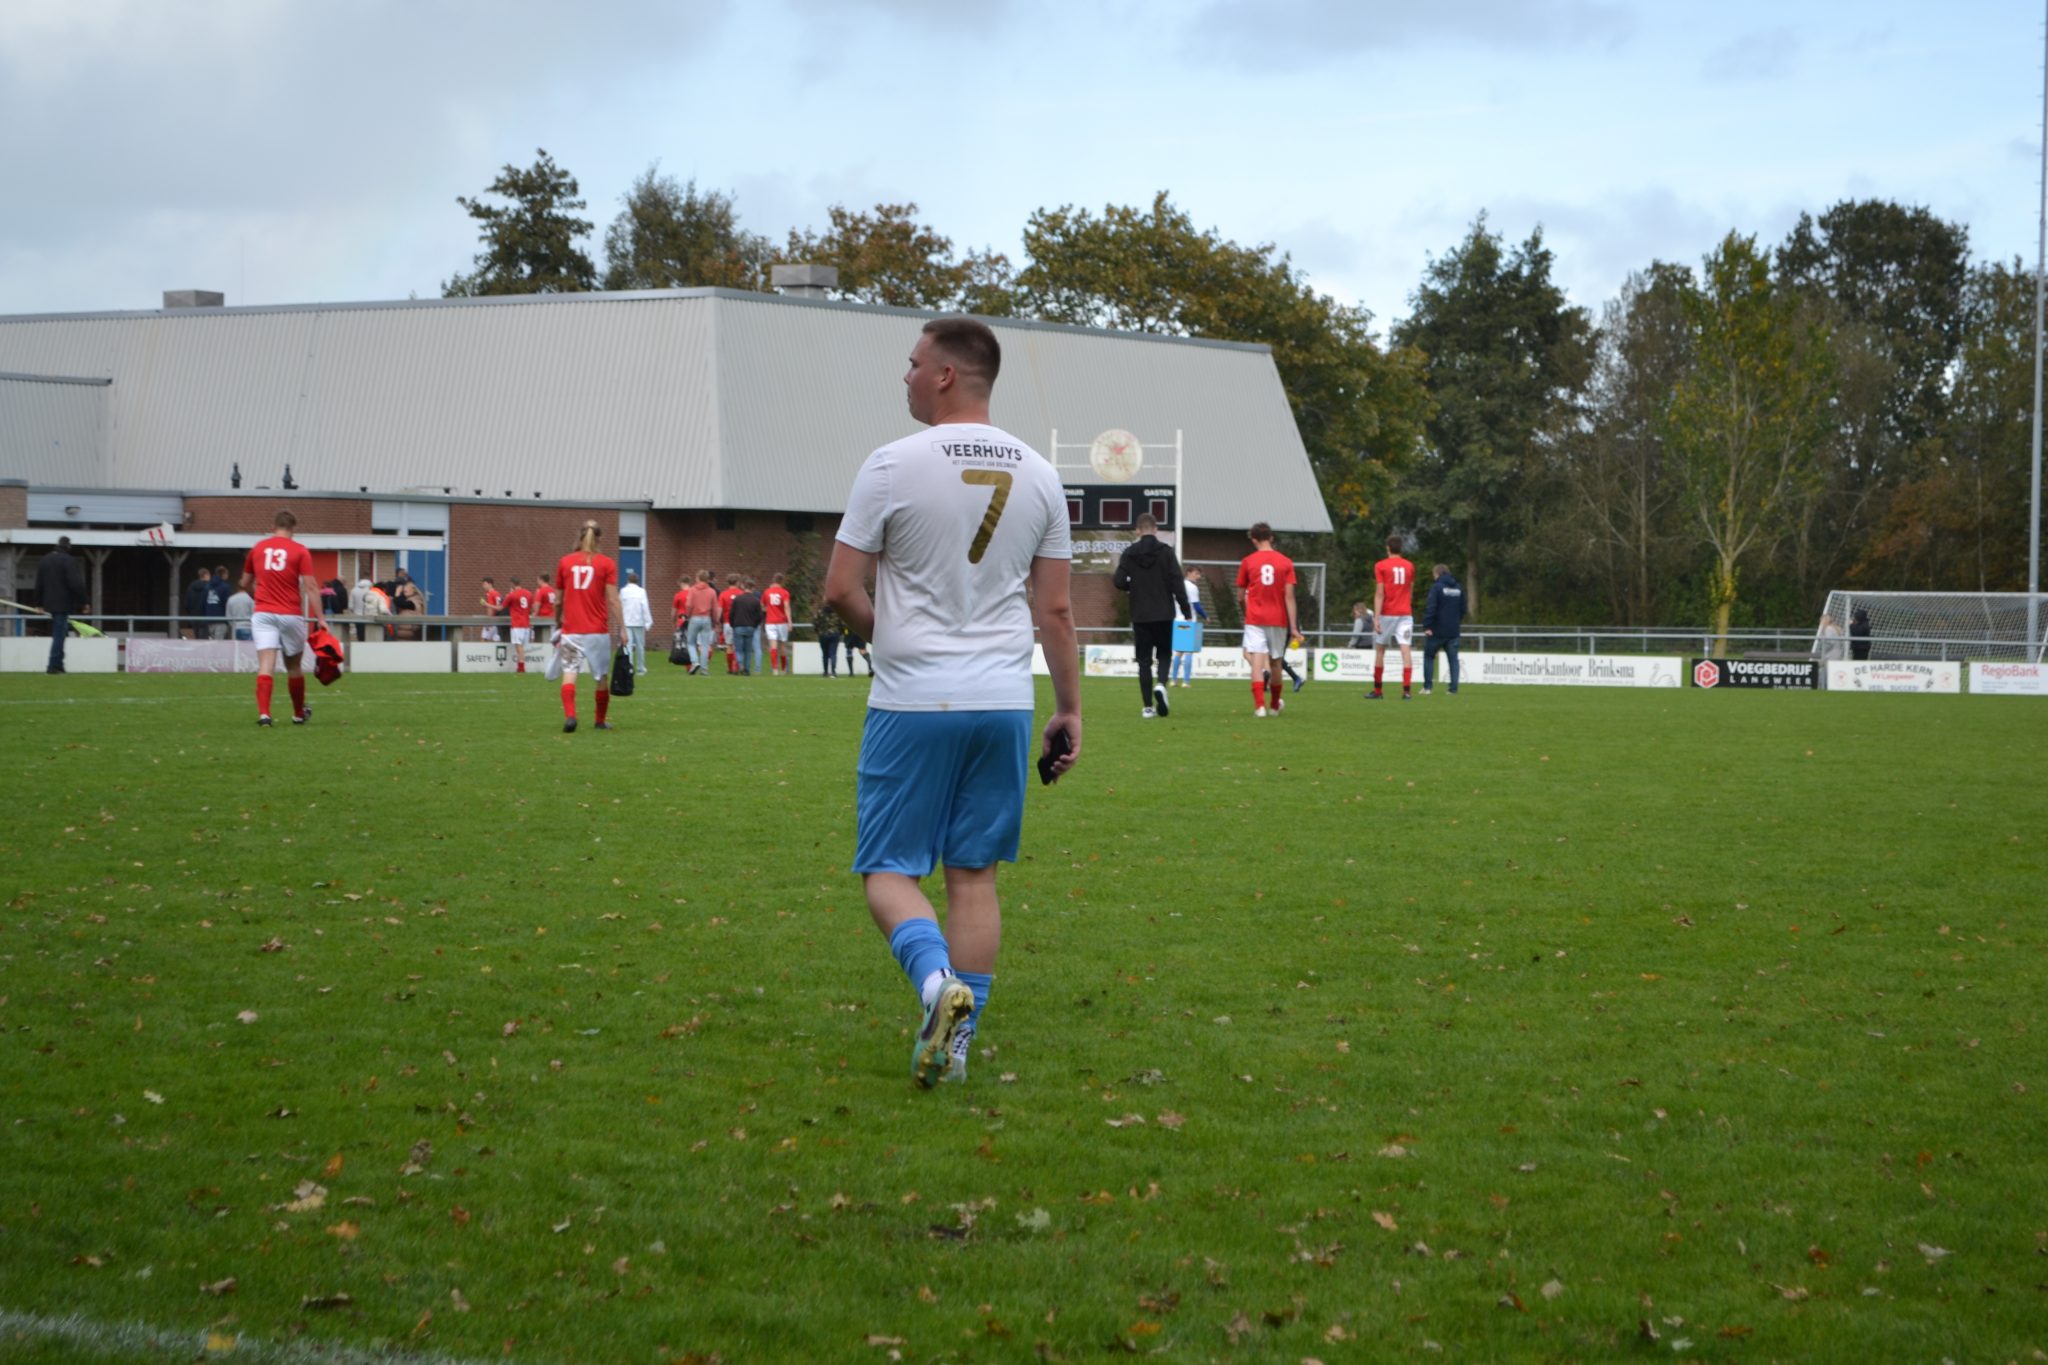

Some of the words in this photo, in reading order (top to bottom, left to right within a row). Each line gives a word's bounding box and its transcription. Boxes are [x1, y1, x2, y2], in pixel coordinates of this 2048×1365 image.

[942, 443, 1022, 461] VEERHUYS
[961, 469, 1013, 564] 7
[263, 547, 288, 572] 13
[570, 564, 595, 590] 17
[1260, 564, 1275, 586] 8
[1392, 566, 1406, 586] 11
[519, 596, 529, 609] 9
[768, 593, 782, 606] 16
[466, 654, 492, 663] SAFETY
[1206, 658, 1235, 668] Export
[1726, 661, 1813, 675] VOEGBEDRIJF
[1853, 665, 1870, 676] DE
[1870, 663, 1904, 672] HARDE
[1906, 664, 1934, 676] KERN
[1982, 664, 2040, 679] RegioBank
[1729, 675, 1812, 685] LANGWEER
